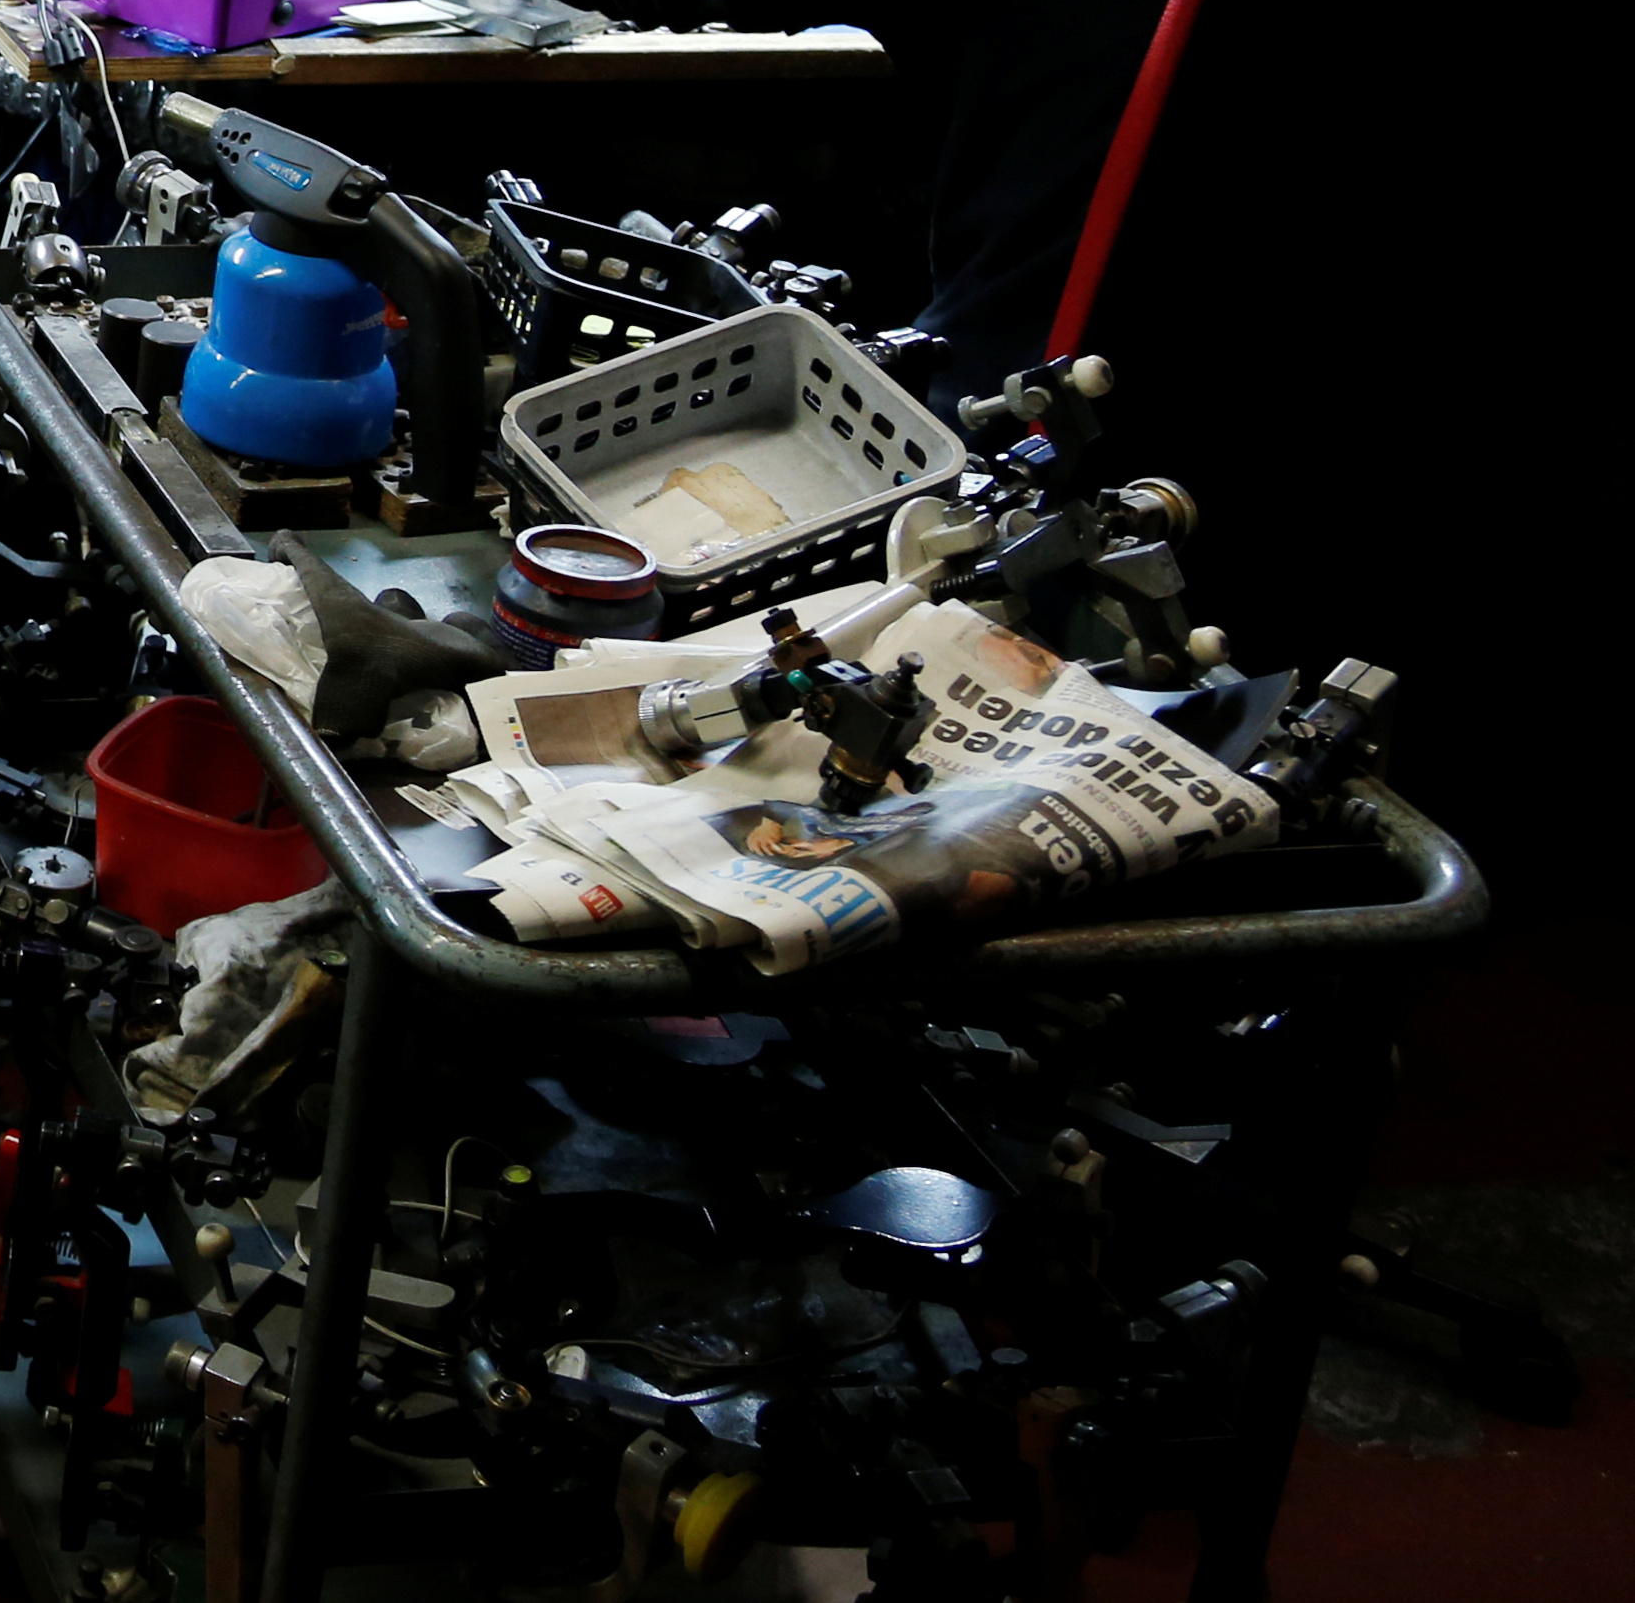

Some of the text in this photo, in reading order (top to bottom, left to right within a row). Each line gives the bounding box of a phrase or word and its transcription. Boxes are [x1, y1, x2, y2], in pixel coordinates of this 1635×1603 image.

[947, 673, 1256, 838] gezin doden
[1038, 751, 1181, 826] wilde
[560, 872, 583, 887] 13
[584, 888, 618, 919] HLN
[708, 856, 893, 946] IEUWS
